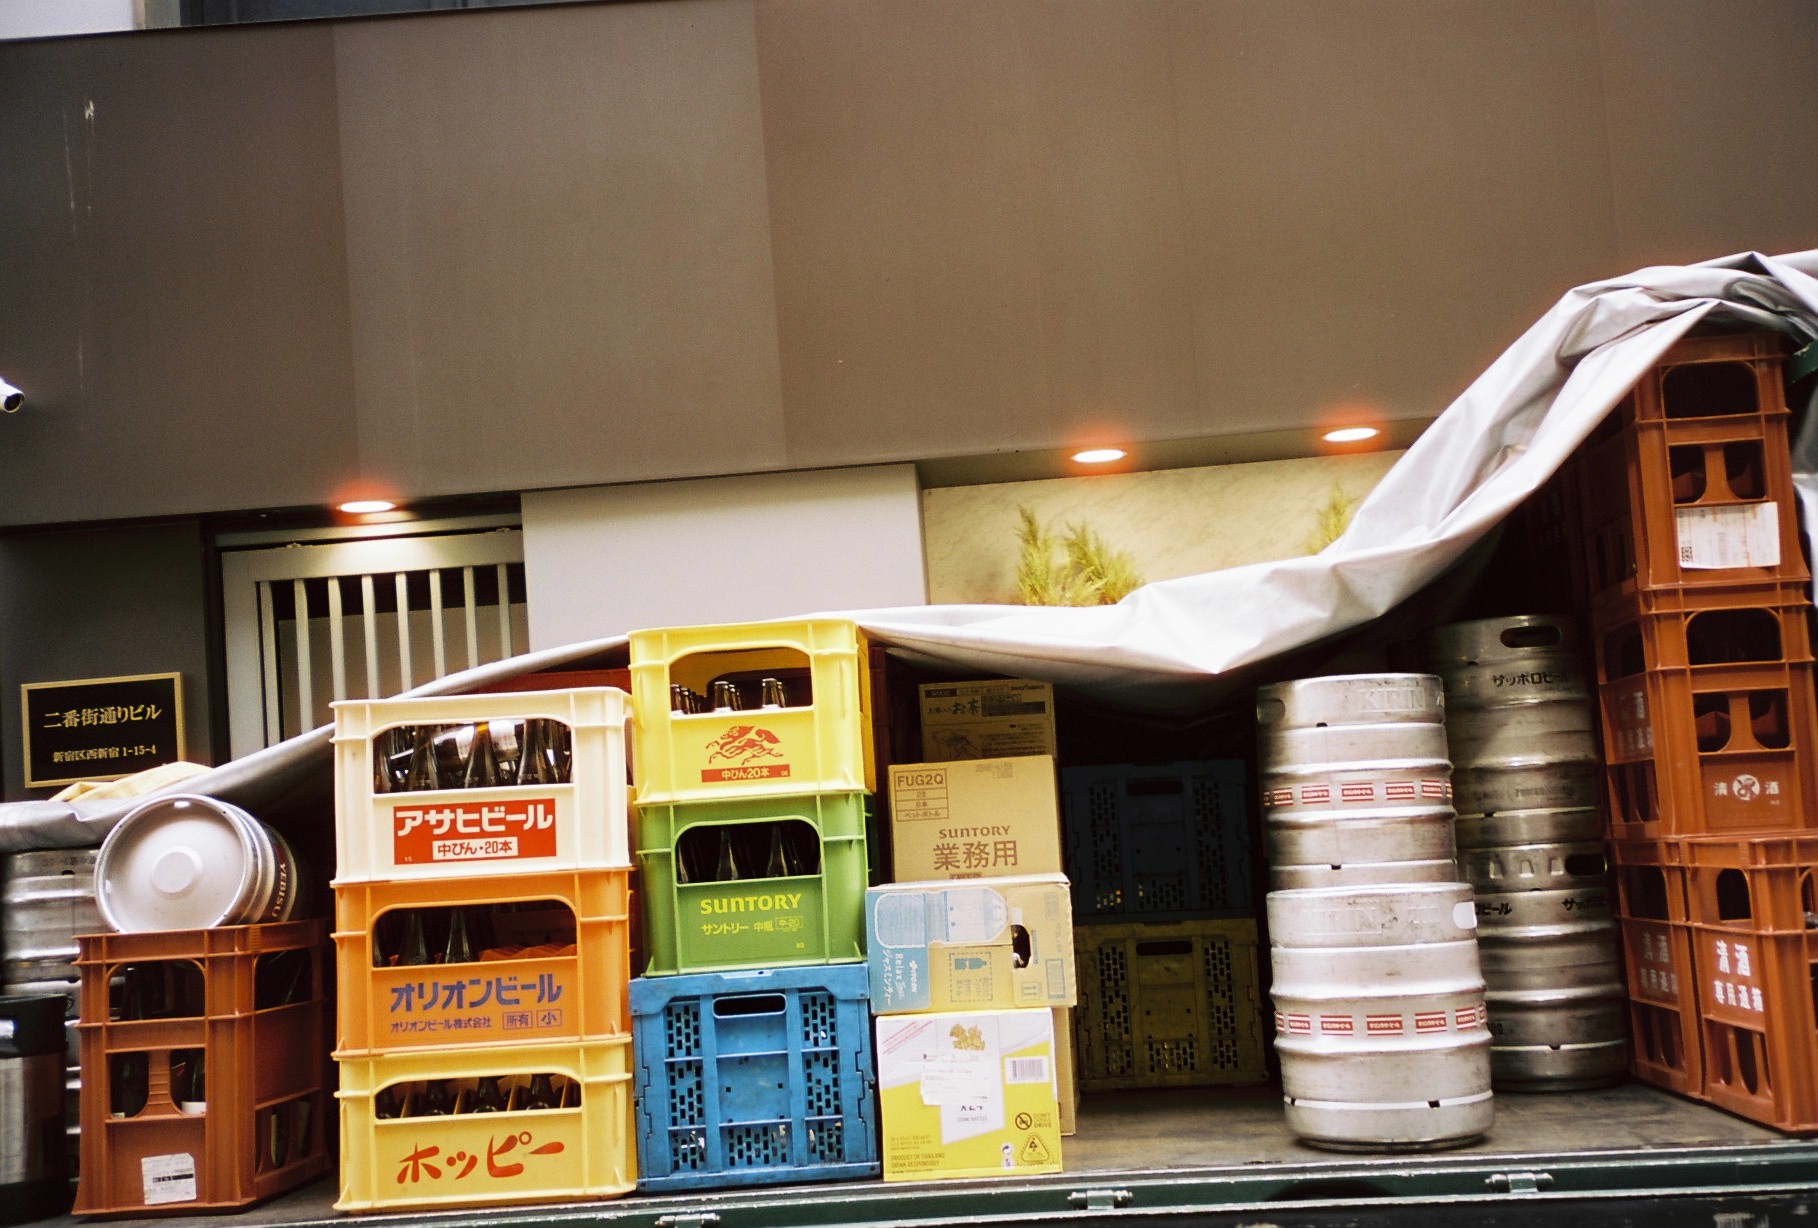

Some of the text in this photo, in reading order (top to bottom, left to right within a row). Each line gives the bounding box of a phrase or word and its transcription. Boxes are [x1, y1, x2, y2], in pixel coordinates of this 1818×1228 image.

[44, 704, 162, 728] 二番街通りビル
[53, 744, 157, 763] 新宿区西新宿 1-15-4
[897, 773, 944, 787] FUG2Q
[396, 804, 553, 837] アサヒビール
[939, 825, 1011, 839] SUNTORY
[933, 839, 1018, 871] 業務用
[271, 862, 287, 918] YEBISU
[700, 893, 802, 915] SUNTORY
[702, 922, 750, 936] サントリー
[894, 953, 905, 980] Relax
[1715, 940, 1751, 976] 清酒
[390, 973, 563, 1013] オリオンビール
[390, 1011, 557, 1033] オリオンビール株式会社 所有 小
[396, 1131, 565, 1184] ホッピー
